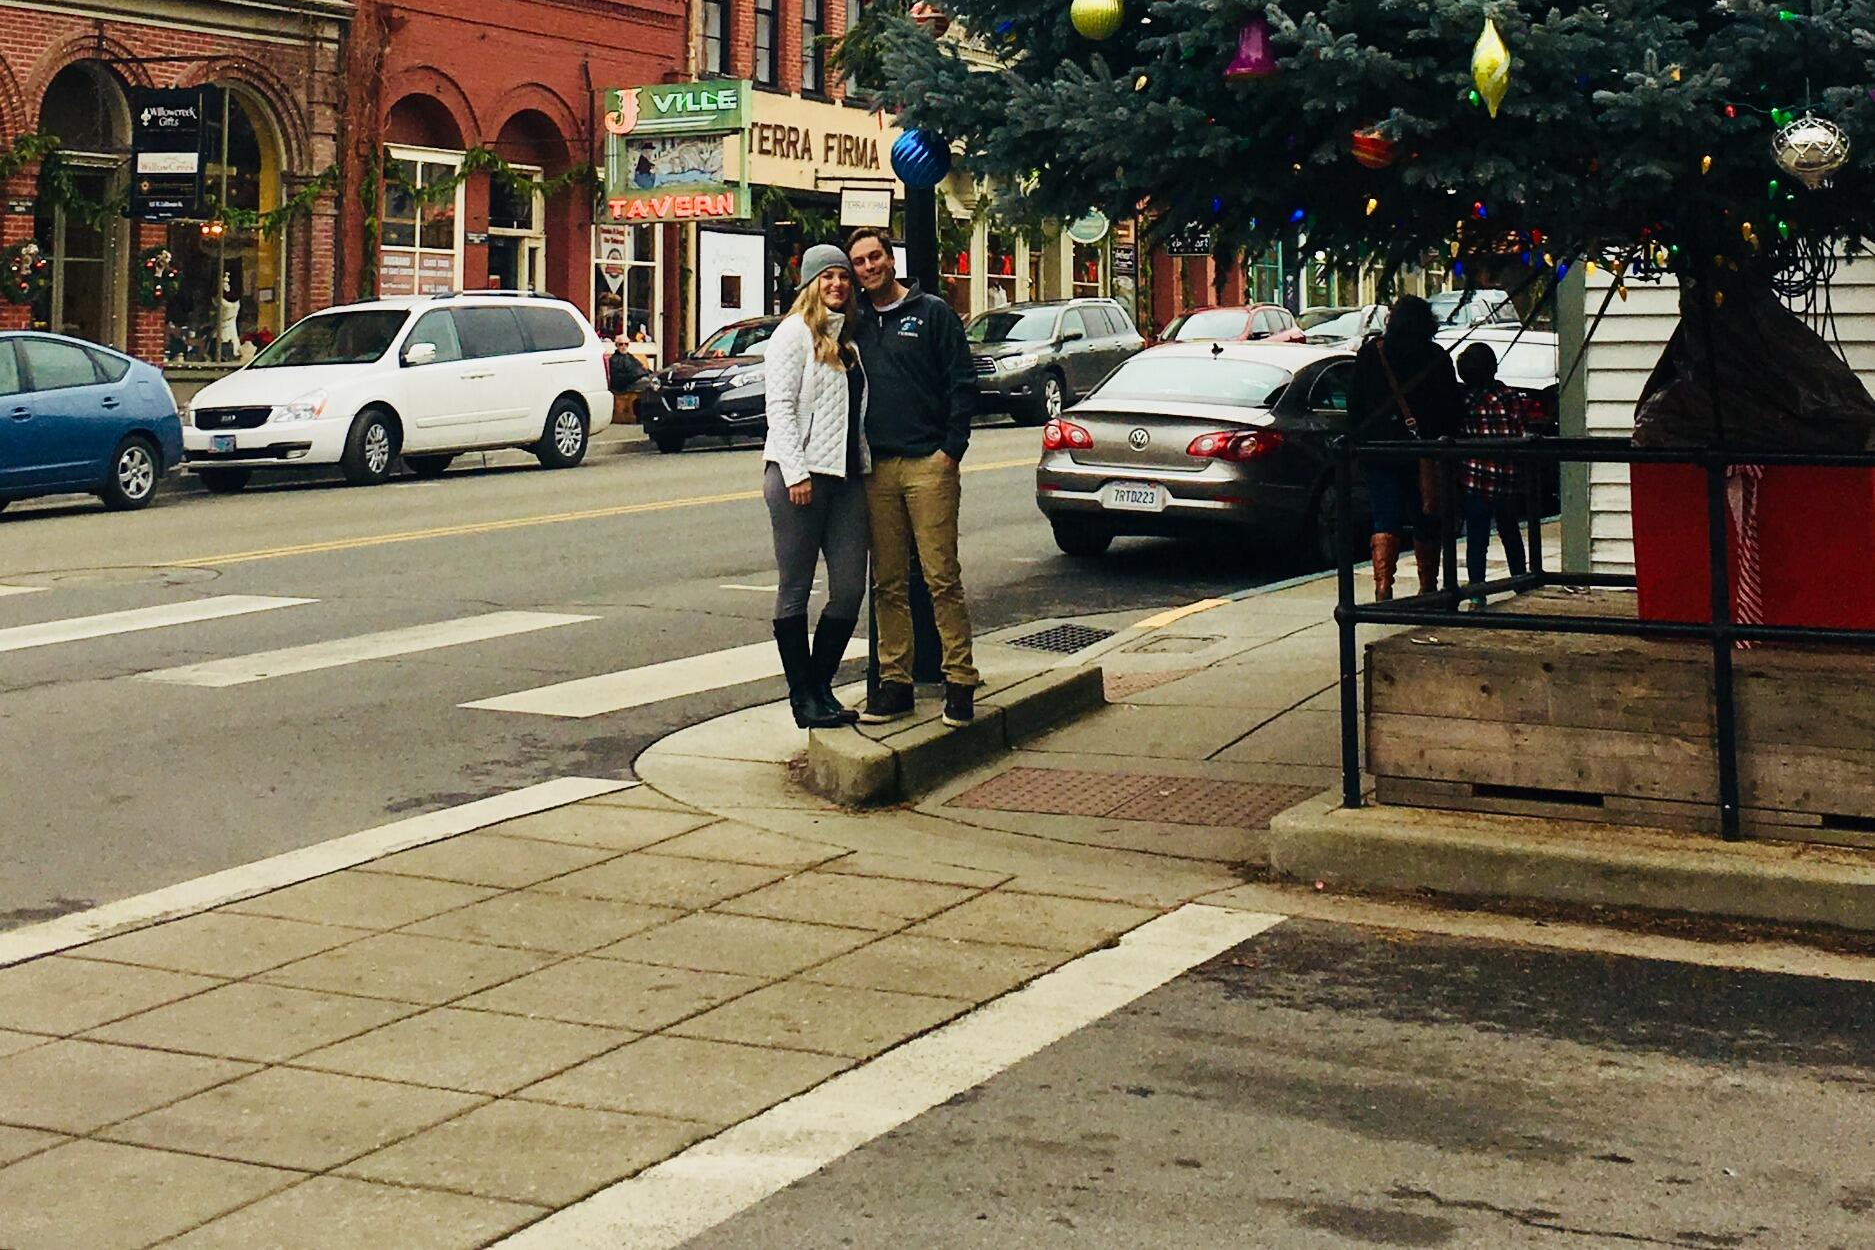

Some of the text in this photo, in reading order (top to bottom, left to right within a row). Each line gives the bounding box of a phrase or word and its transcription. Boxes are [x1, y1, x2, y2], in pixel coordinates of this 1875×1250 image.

[605, 88, 738, 134] J VILLE
[159, 117, 180, 127] Gifts
[748, 121, 880, 170] TERRA FIRMA
[608, 191, 735, 219] TAVERN
[844, 200, 889, 211] TERRA FIRMA
[1114, 489, 1155, 504] 7RTD223
